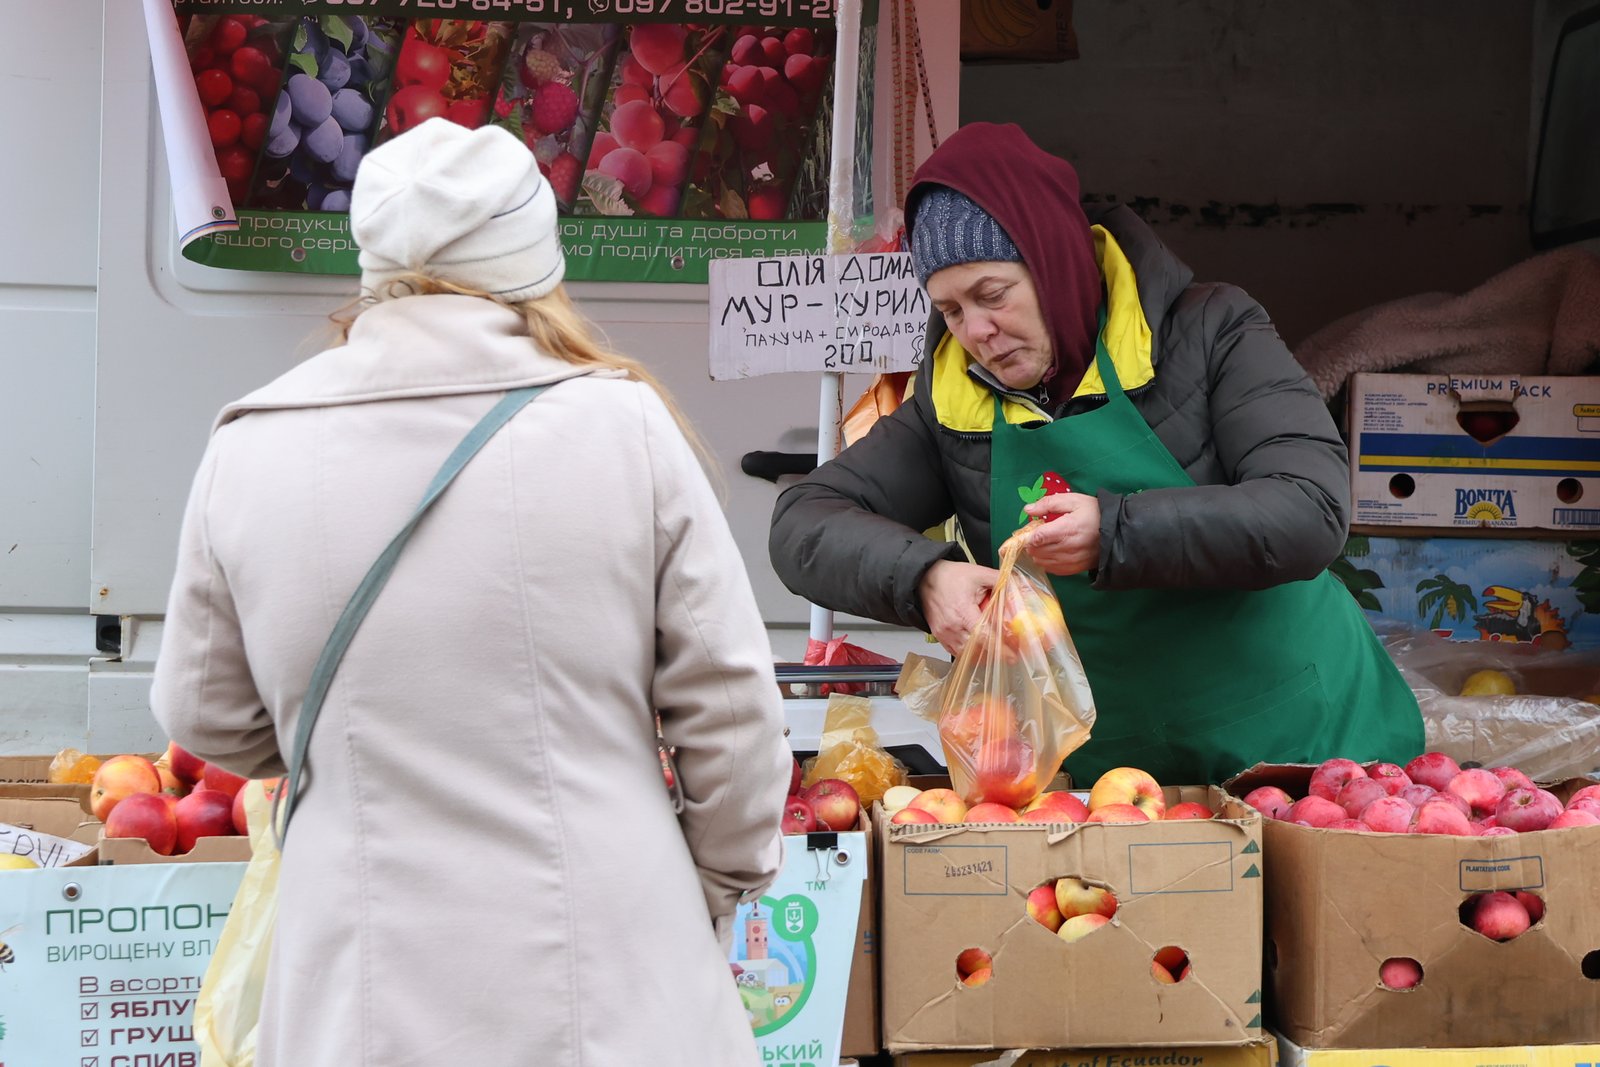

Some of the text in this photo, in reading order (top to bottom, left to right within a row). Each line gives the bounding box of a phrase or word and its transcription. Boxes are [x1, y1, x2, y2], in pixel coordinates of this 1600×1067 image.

[592, 222, 647, 241] душі
[656, 226, 683, 238] та
[691, 225, 797, 243] доброти
[601, 242, 742, 261] поділитися
[774, 248, 828, 258] вам
[824, 341, 873, 368] 200
[1427, 378, 1552, 398] PREMIUM PACK
[1454, 488, 1517, 517] BONITA
[47, 939, 217, 963] ВИРОЩЕНУ ВЛ
[79, 976, 99, 994] В
[110, 999, 197, 1018] ЯБЛУ
[110, 1052, 202, 1067] СЛИВ
[757, 1039, 823, 1061] ЬКИЙ
[1106, 1051, 1205, 1067] Ecuador
